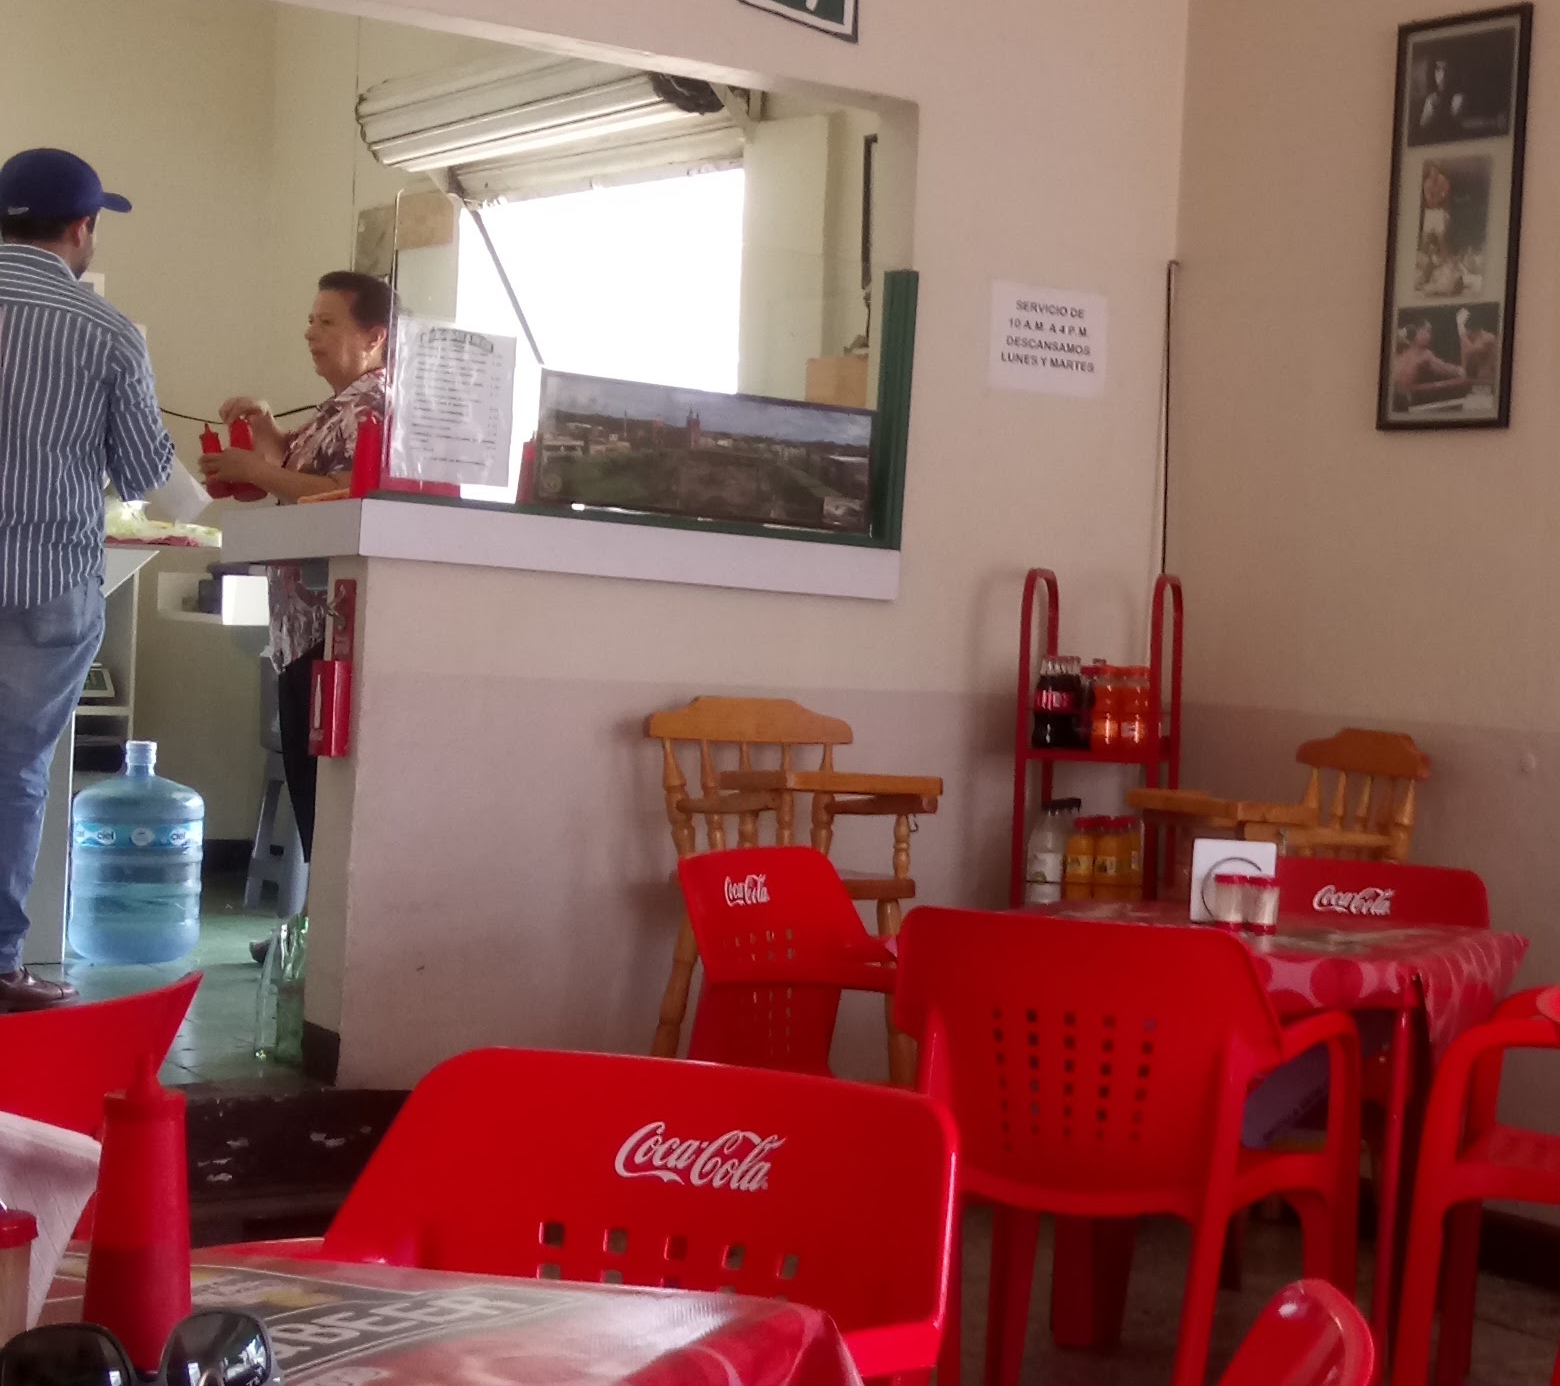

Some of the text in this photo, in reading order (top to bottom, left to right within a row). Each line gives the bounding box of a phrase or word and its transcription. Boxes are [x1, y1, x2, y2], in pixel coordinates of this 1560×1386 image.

[1016, 299, 1085, 319] SERVICIO DE
[1009, 317, 1021, 329] 10
[1006, 334, 1091, 356] DESCANSAMOS
[1001, 351, 1095, 373] LUNES Y MARTES
[724, 873, 771, 907] Coca-Cola
[1312, 884, 1395, 916] Coca-Cola
[614, 1121, 788, 1192] Coca-Cola
